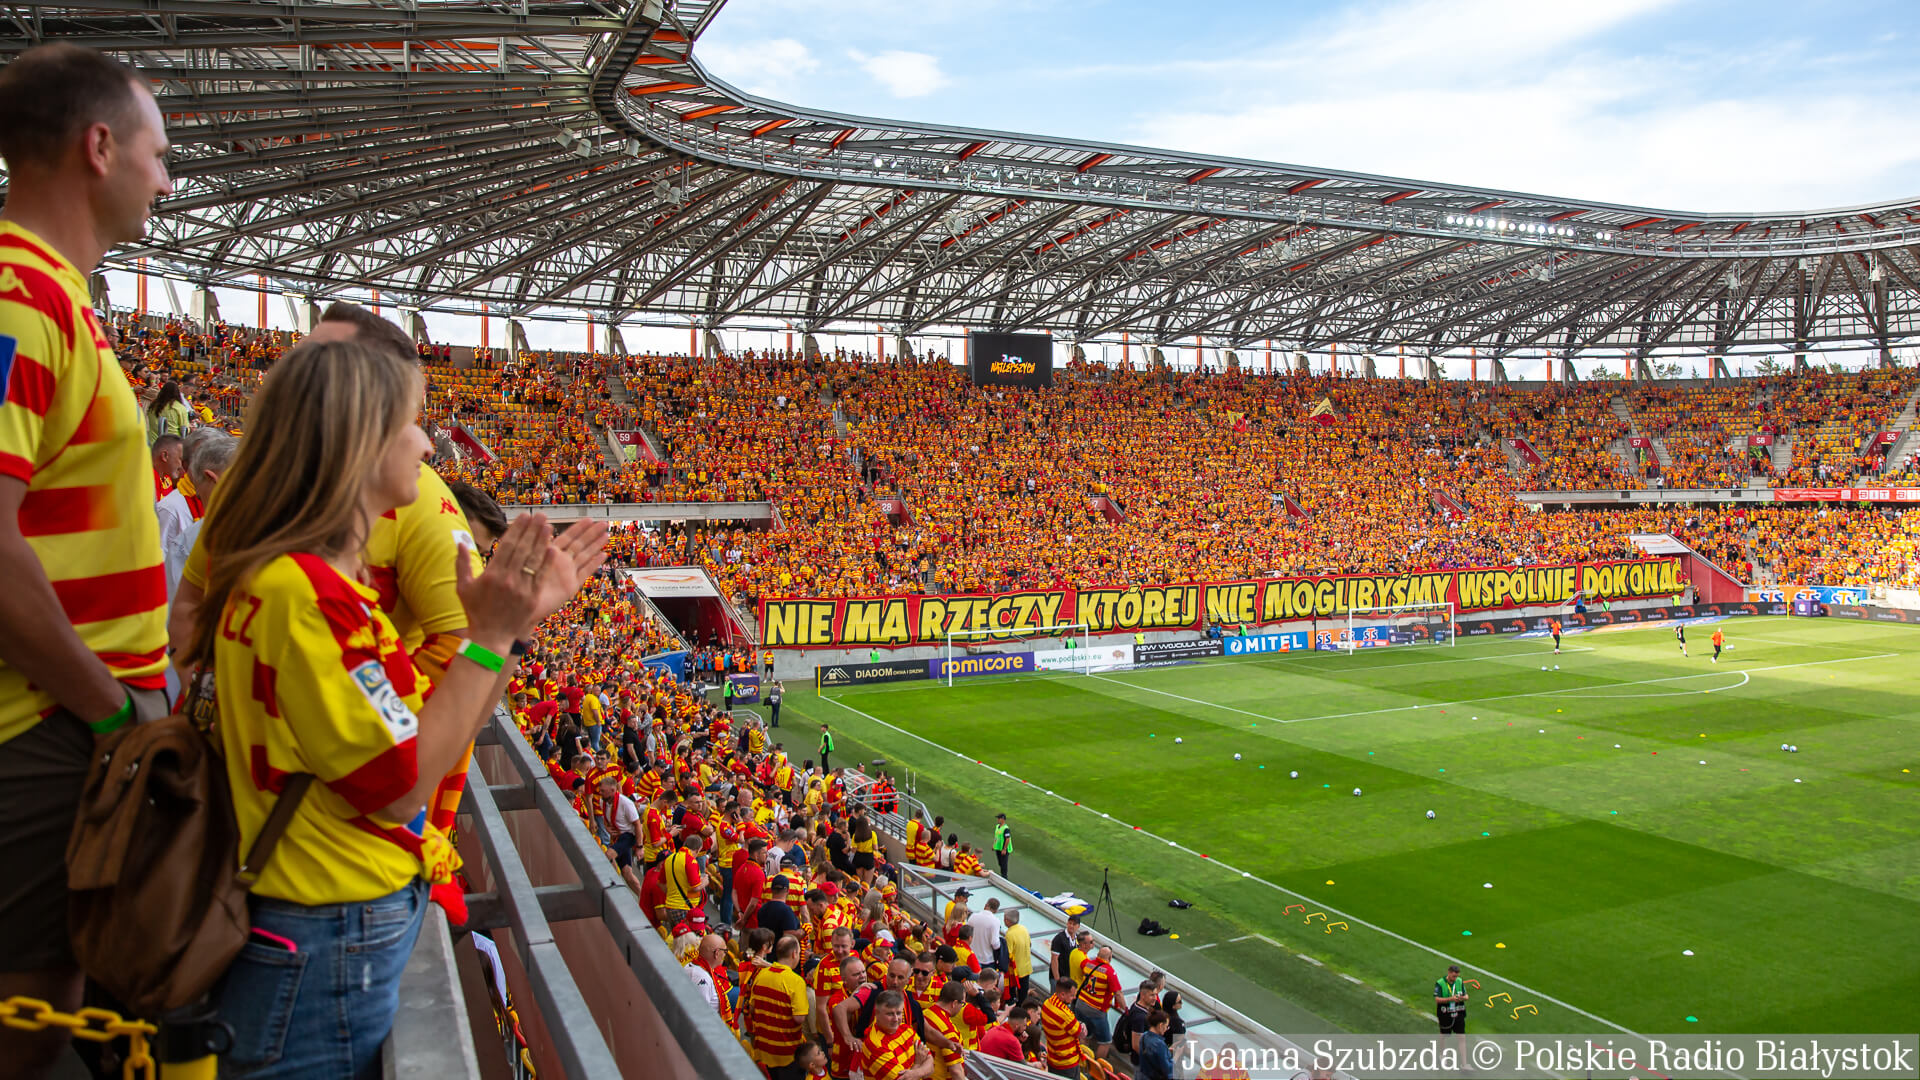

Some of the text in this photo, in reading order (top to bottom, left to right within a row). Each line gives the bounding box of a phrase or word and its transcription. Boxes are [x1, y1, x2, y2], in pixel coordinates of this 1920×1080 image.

[619, 433, 630, 441] 59
[764, 601, 836, 646] NIE
[838, 598, 911, 645] MA
[916, 591, 1070, 641] RZECZY,
[1075, 584, 1200, 633] KTÓREJ
[1203, 583, 1258, 625] NIE
[1262, 573, 1453, 622] MOGLIBYŚMY
[1458, 565, 1577, 609] WSPÓLNIE
[1317, 631, 1331, 645] STS
[1364, 628, 1378, 641] STS
[1245, 634, 1303, 652] MITEL
[855, 668, 893, 679] DIADOM
